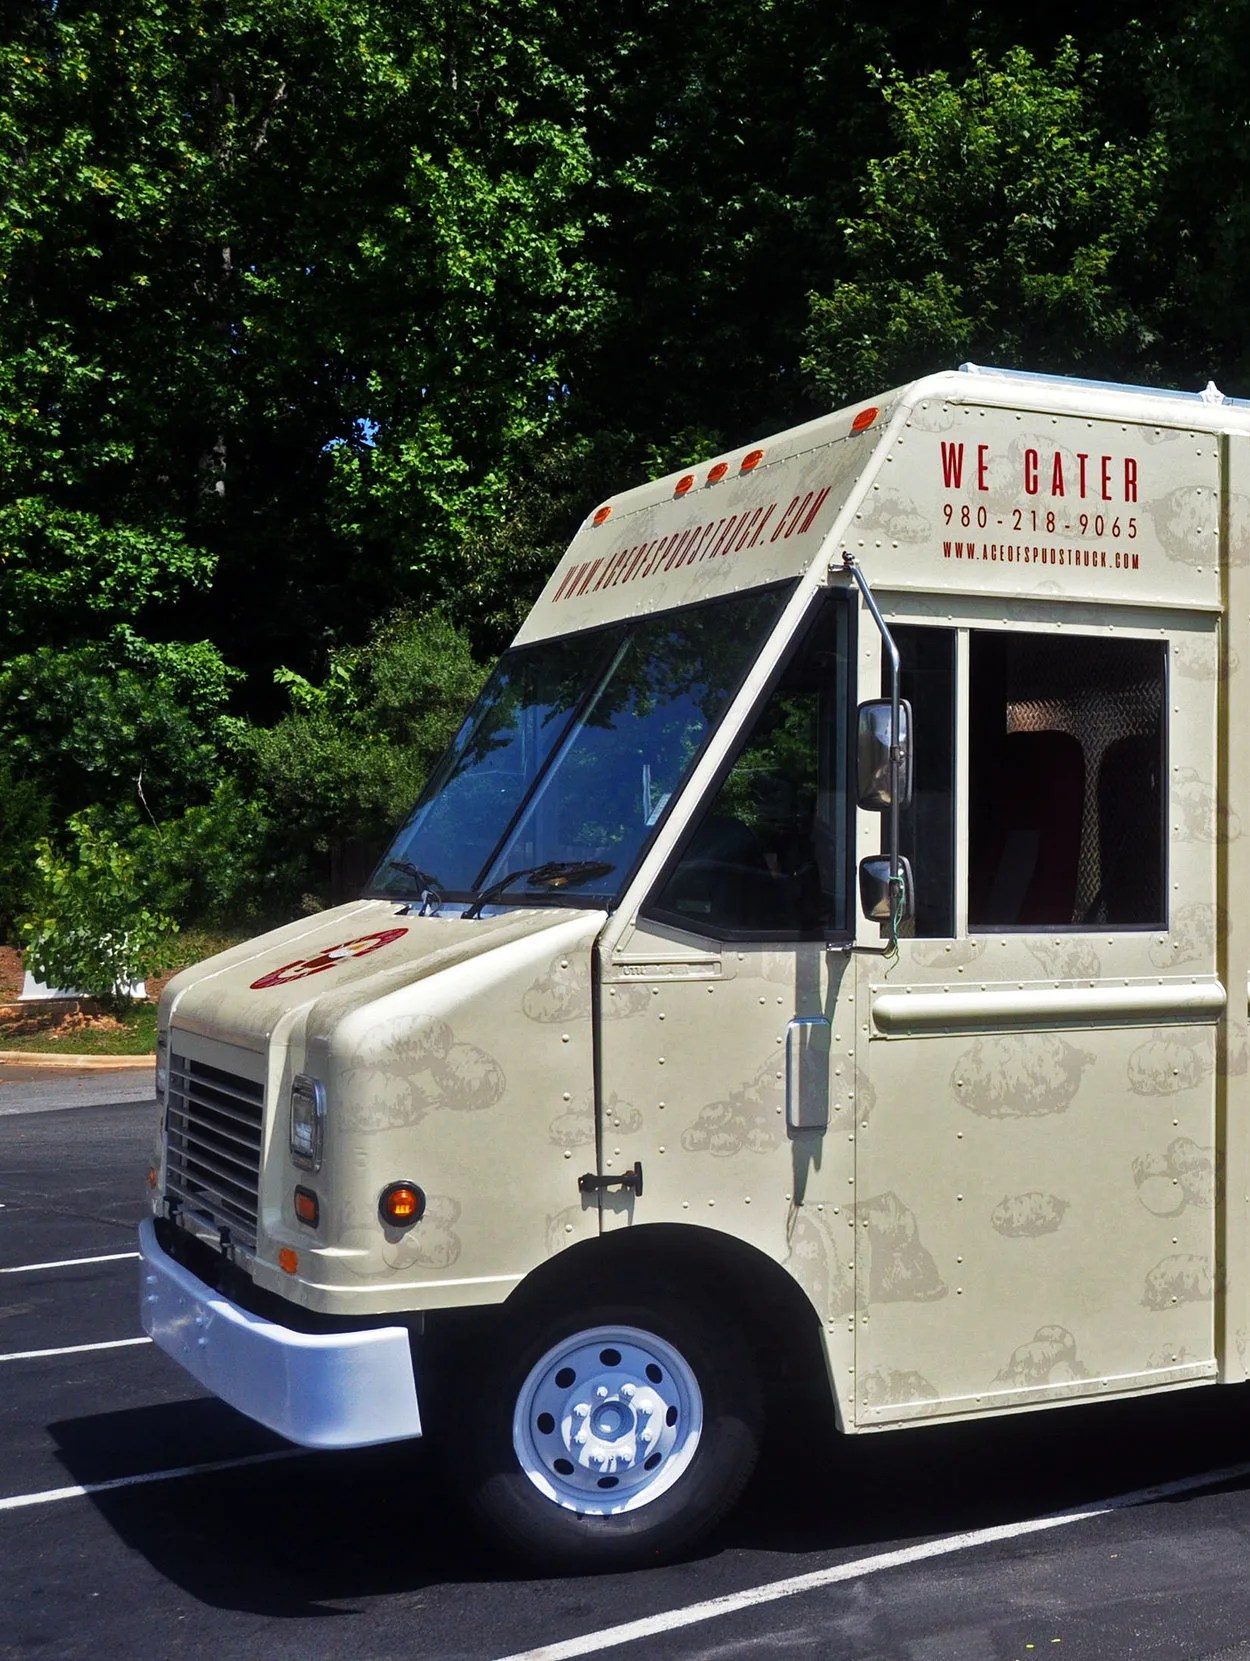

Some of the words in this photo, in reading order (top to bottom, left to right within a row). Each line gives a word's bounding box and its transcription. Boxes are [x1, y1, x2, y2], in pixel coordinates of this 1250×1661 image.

[941, 441, 989, 491] WE
[1024, 448, 1138, 502] CATER
[552, 485, 832, 602] WWW.ACEOFSPUDSTRUCK.COM
[943, 503, 1137, 539] 980-218-9065
[943, 541, 1139, 570] WWW.ACEOFSPUDSTRUCK.COM
